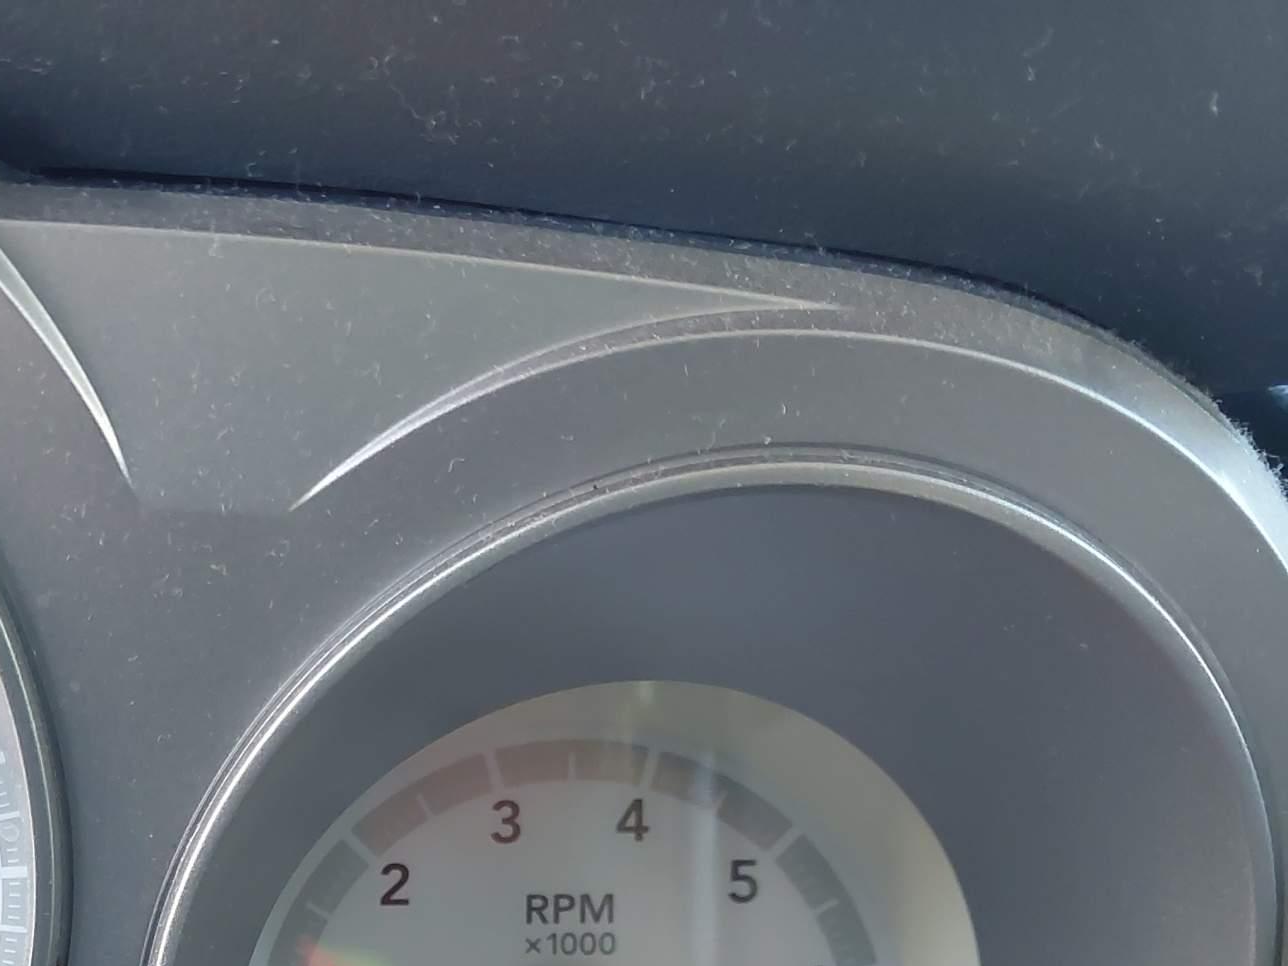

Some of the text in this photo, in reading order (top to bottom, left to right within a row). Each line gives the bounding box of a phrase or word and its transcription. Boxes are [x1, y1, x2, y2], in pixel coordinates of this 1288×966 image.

[490, 799, 522, 844] 3
[616, 798, 650, 842] 4
[379, 861, 411, 906] 2
[727, 859, 759, 904] 5
[525, 893, 615, 925] RPM
